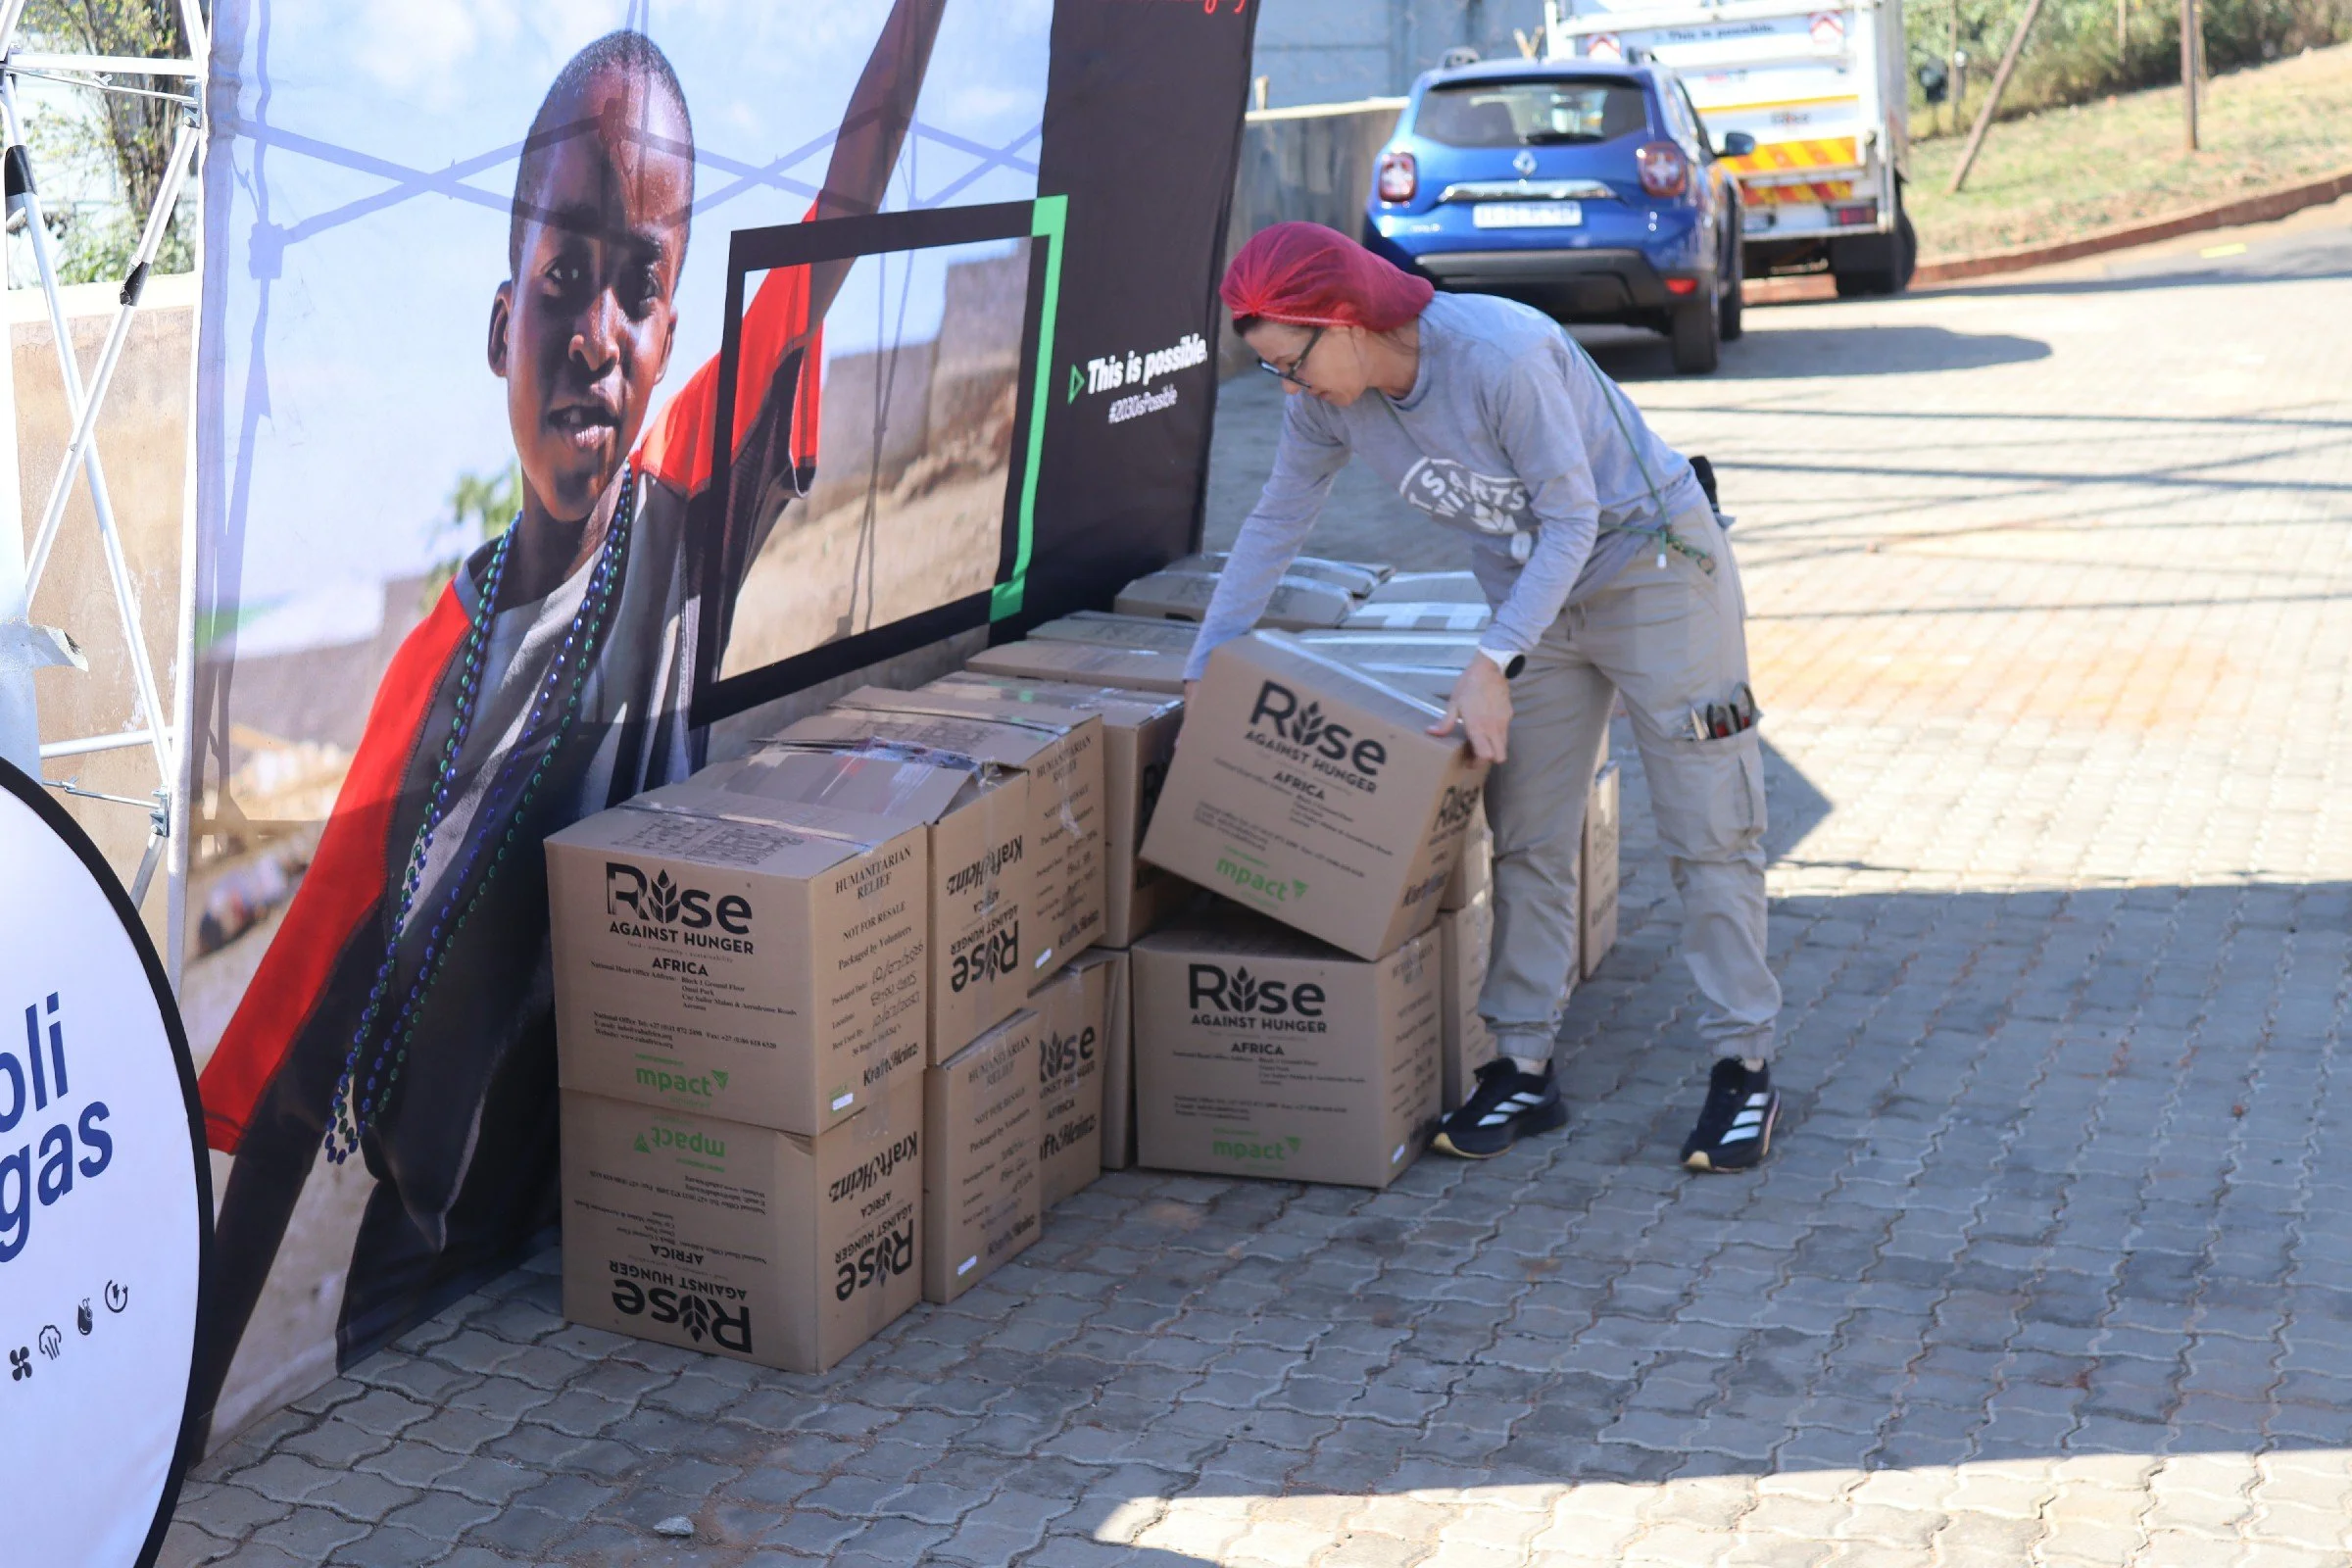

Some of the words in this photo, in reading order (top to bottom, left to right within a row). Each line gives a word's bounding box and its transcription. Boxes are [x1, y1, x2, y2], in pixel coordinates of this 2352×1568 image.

[1087, 354, 1124, 395] This
[1125, 349, 1143, 384] is
[1249, 679, 1387, 776] Rise
[1244, 730, 1310, 764] AGAINST
[1312, 758, 1378, 795] HUNGER
[1273, 771, 1325, 801] AFRICA
[835, 846, 911, 894] HUMANITARIAN
[858, 871, 893, 900] RELIEF
[1214, 857, 1289, 903] mpact
[606, 861, 753, 936] Rise
[843, 925, 859, 942] NOT
[861, 916, 876, 933] FOR
[877, 901, 906, 924] RESALE
[986, 905, 1018, 934] AGAINST
[609, 920, 678, 944] AGAINST
[684, 932, 755, 956] HUNGER
[838, 946, 869, 970] Packaged
[879, 924, 912, 948] Volunteers
[951, 924, 985, 956] HUNGER
[651, 956, 710, 977] AFRICA
[951, 919, 1018, 994] Rise
[1189, 963, 1326, 1017] Rise
[1191, 1014, 1256, 1030] AGAINST
[1261, 1017, 1328, 1034] HUNGER
[1231, 1042, 1285, 1055] AFRICA
[635, 1067, 712, 1098] mpact
[651, 1127, 725, 1157] mpact
[1211, 1140, 1286, 1160] mpact
[0, 1101, 114, 1263] gas
[860, 1190, 892, 1218] AFRICA
[877, 1202, 913, 1237] AGAINST
[650, 1244, 704, 1265] AFRICA
[835, 1230, 875, 1264] HUNGER
[836, 1218, 913, 1301] Rise
[610, 1260, 674, 1287] HUNGER
[678, 1277, 747, 1301] AGAINST
[612, 1279, 754, 1354] Rise
